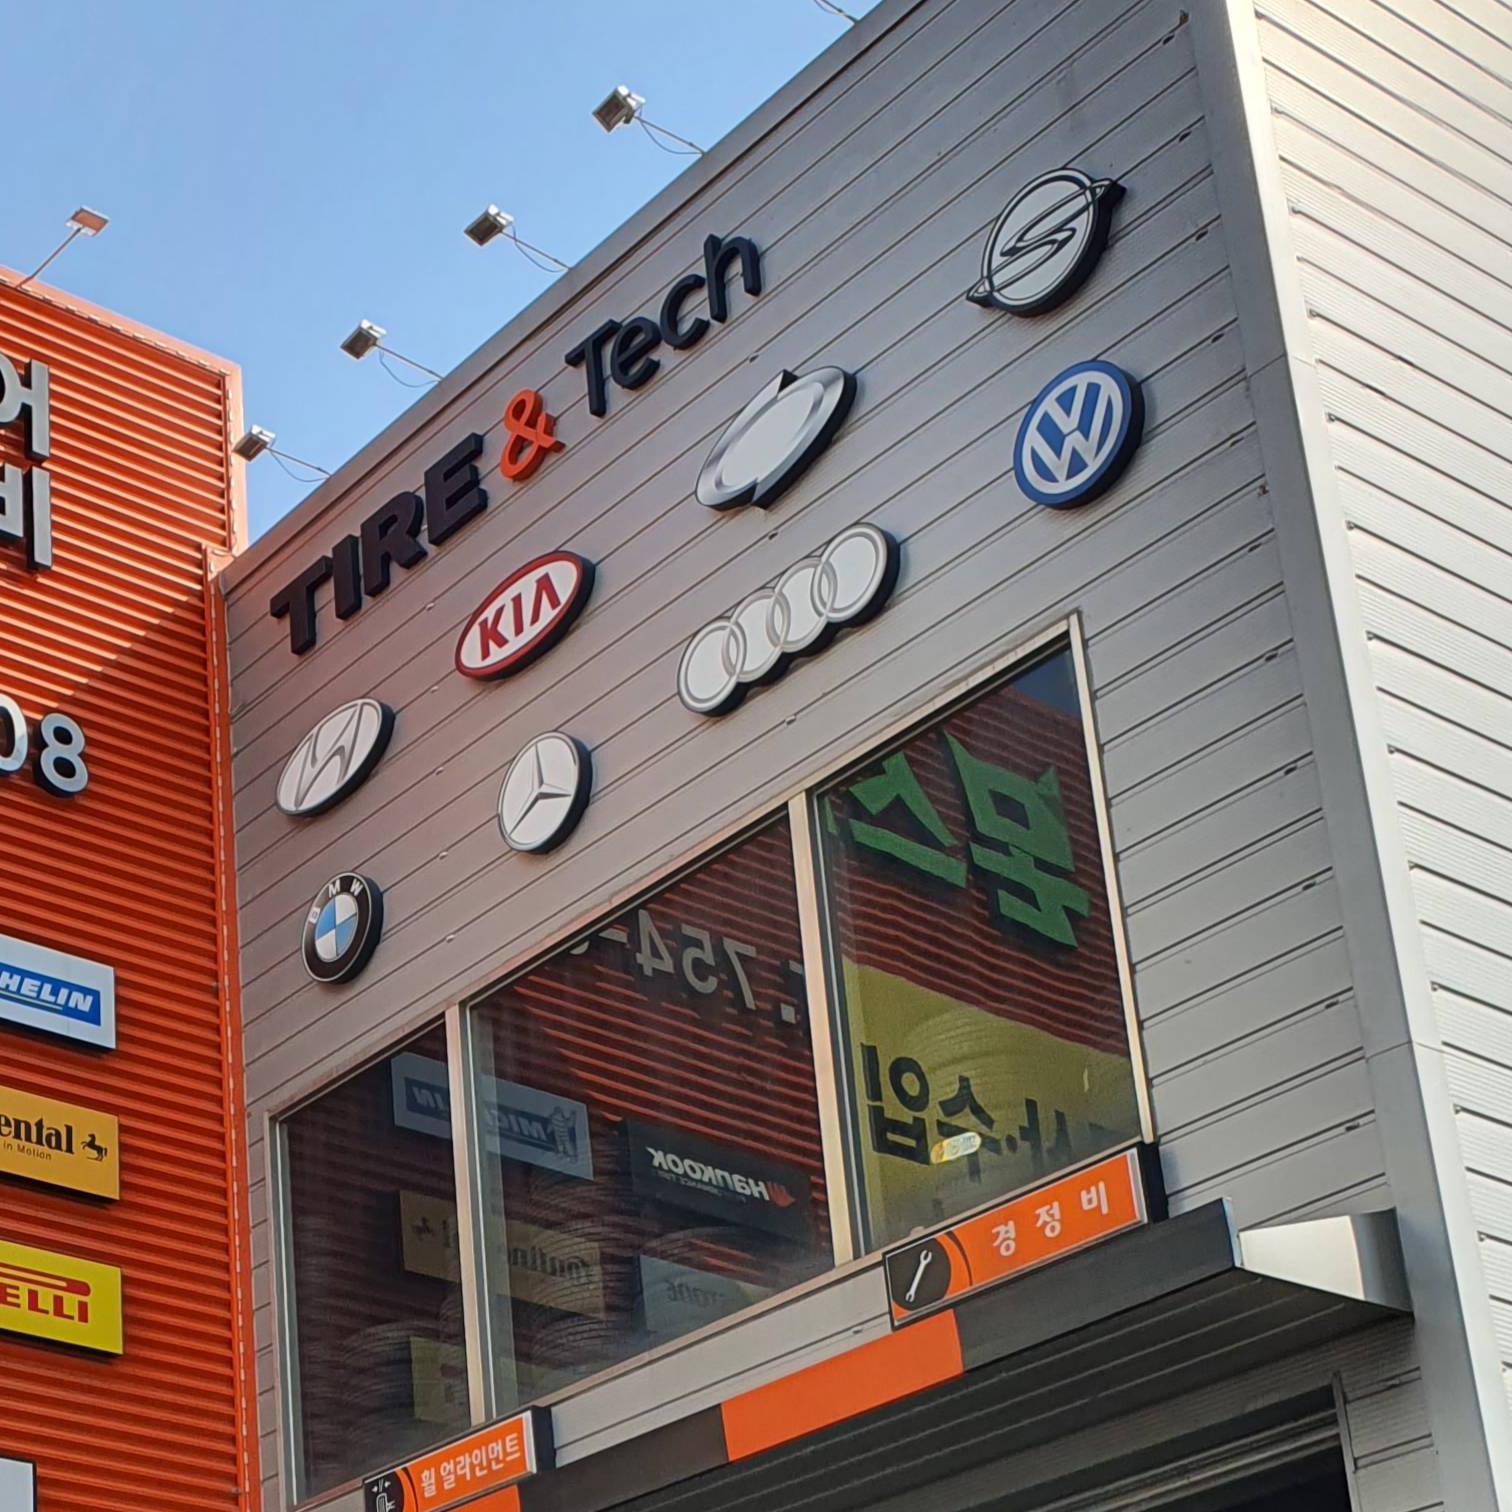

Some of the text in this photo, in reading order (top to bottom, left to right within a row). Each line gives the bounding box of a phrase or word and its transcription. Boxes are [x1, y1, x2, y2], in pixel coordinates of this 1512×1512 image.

[269, 233, 762, 656] TIRE & Tech
[478, 571, 562, 662] KIA
[308, 879, 363, 924] BMW
[3, 1140, 13, 1151] in
[17, 1144, 52, 1161] Motion
